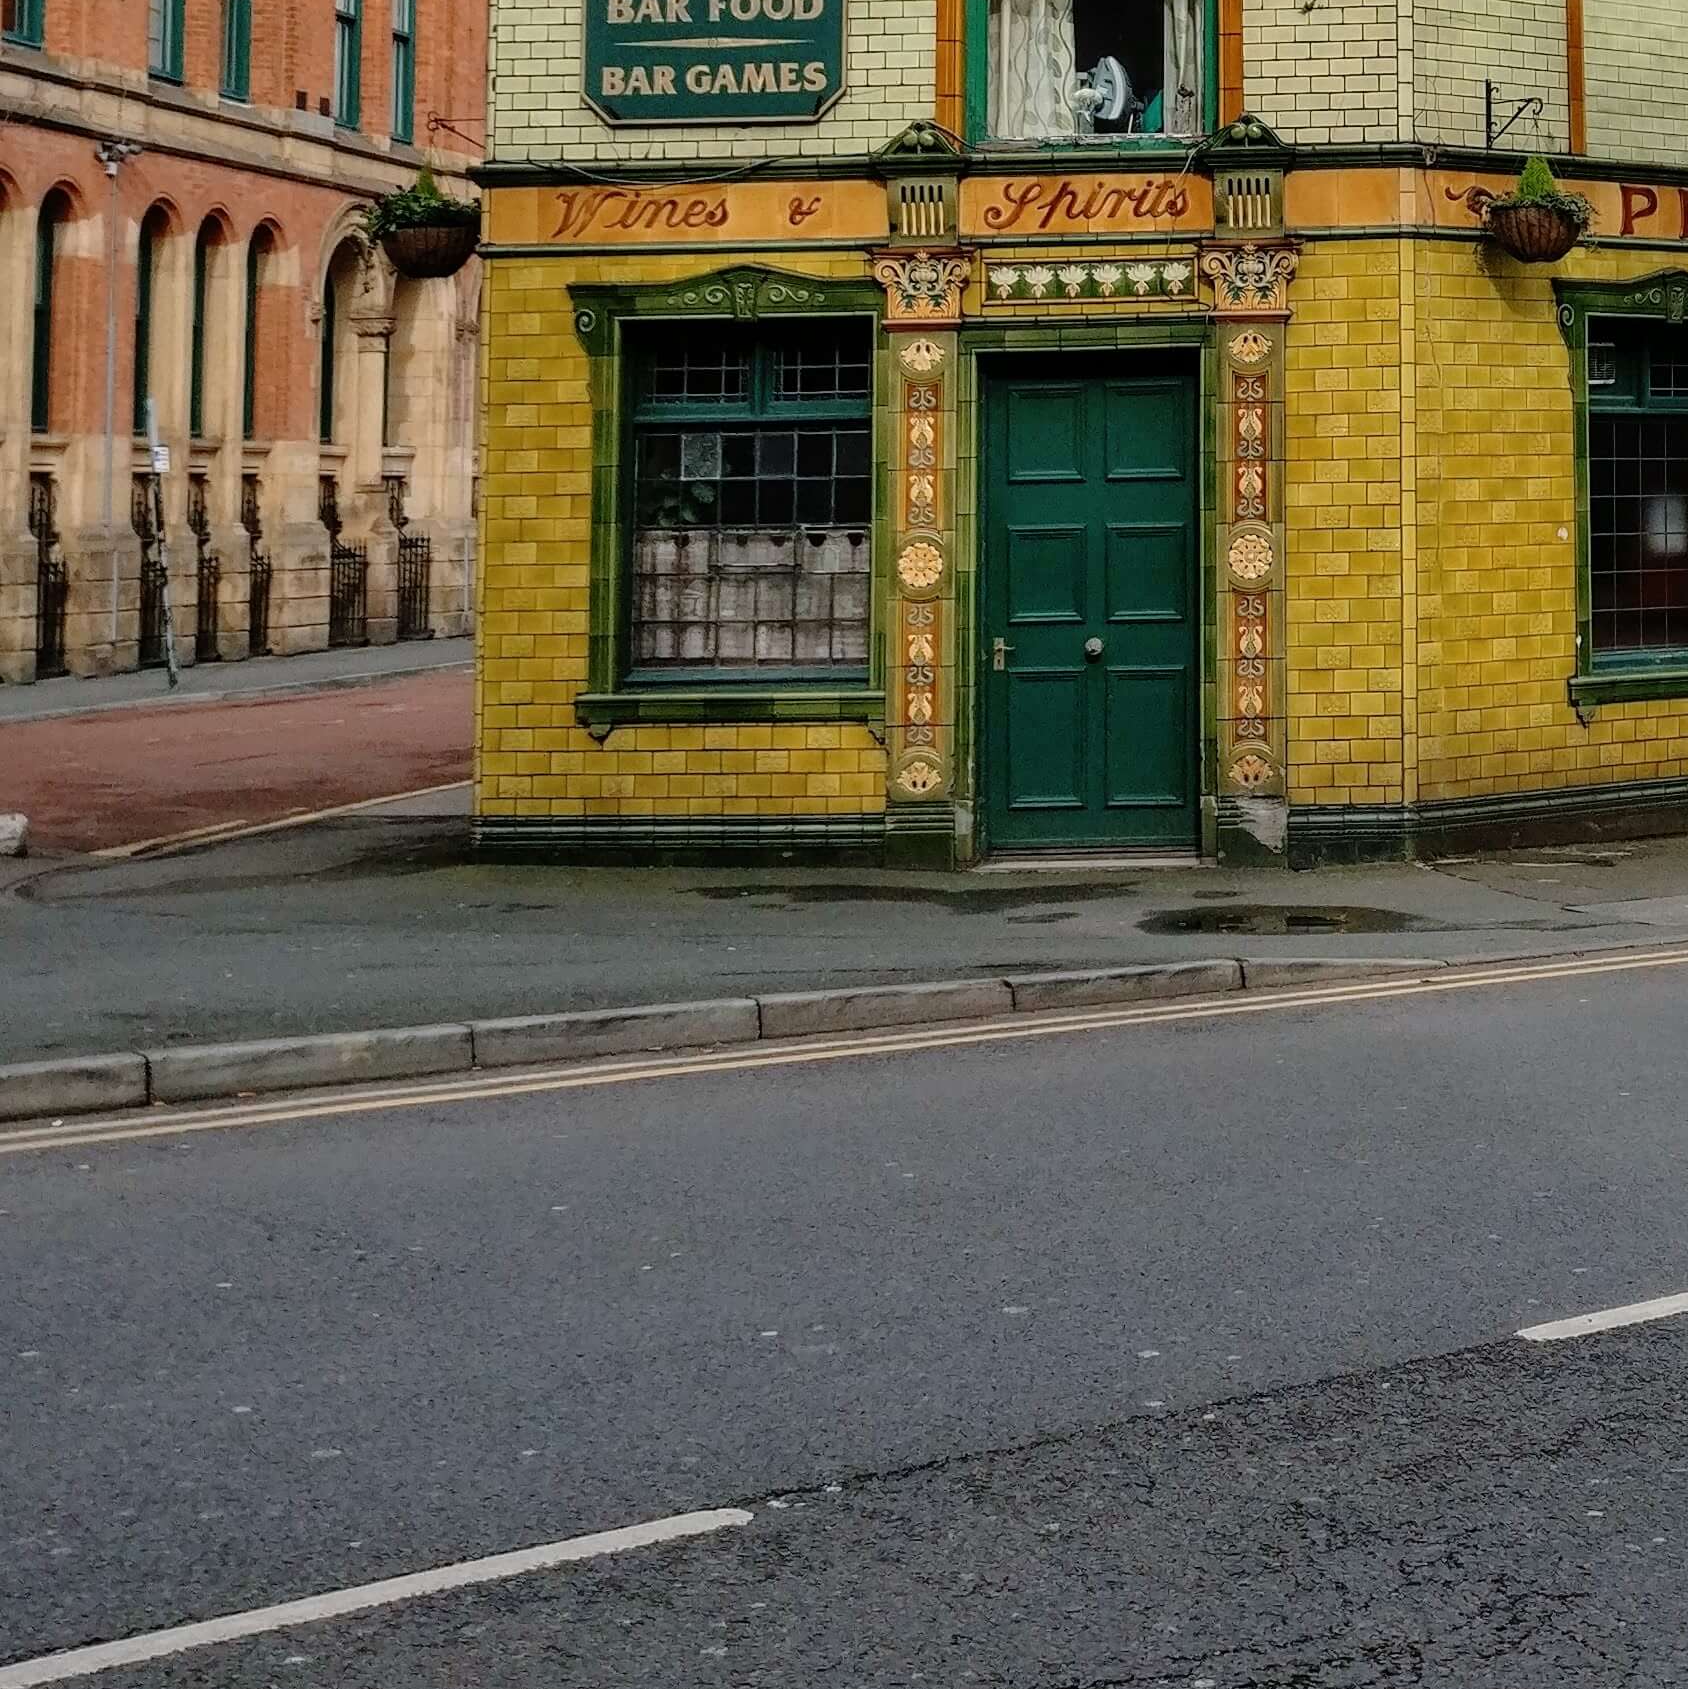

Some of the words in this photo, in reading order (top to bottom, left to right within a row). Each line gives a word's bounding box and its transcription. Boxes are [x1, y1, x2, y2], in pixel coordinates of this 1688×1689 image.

[601, 65, 678, 97] BAR
[685, 61, 828, 95] GAMES
[551, 190, 730, 239] Wines
[788, 196, 822, 226] &
[984, 180, 1189, 230] Spirits
